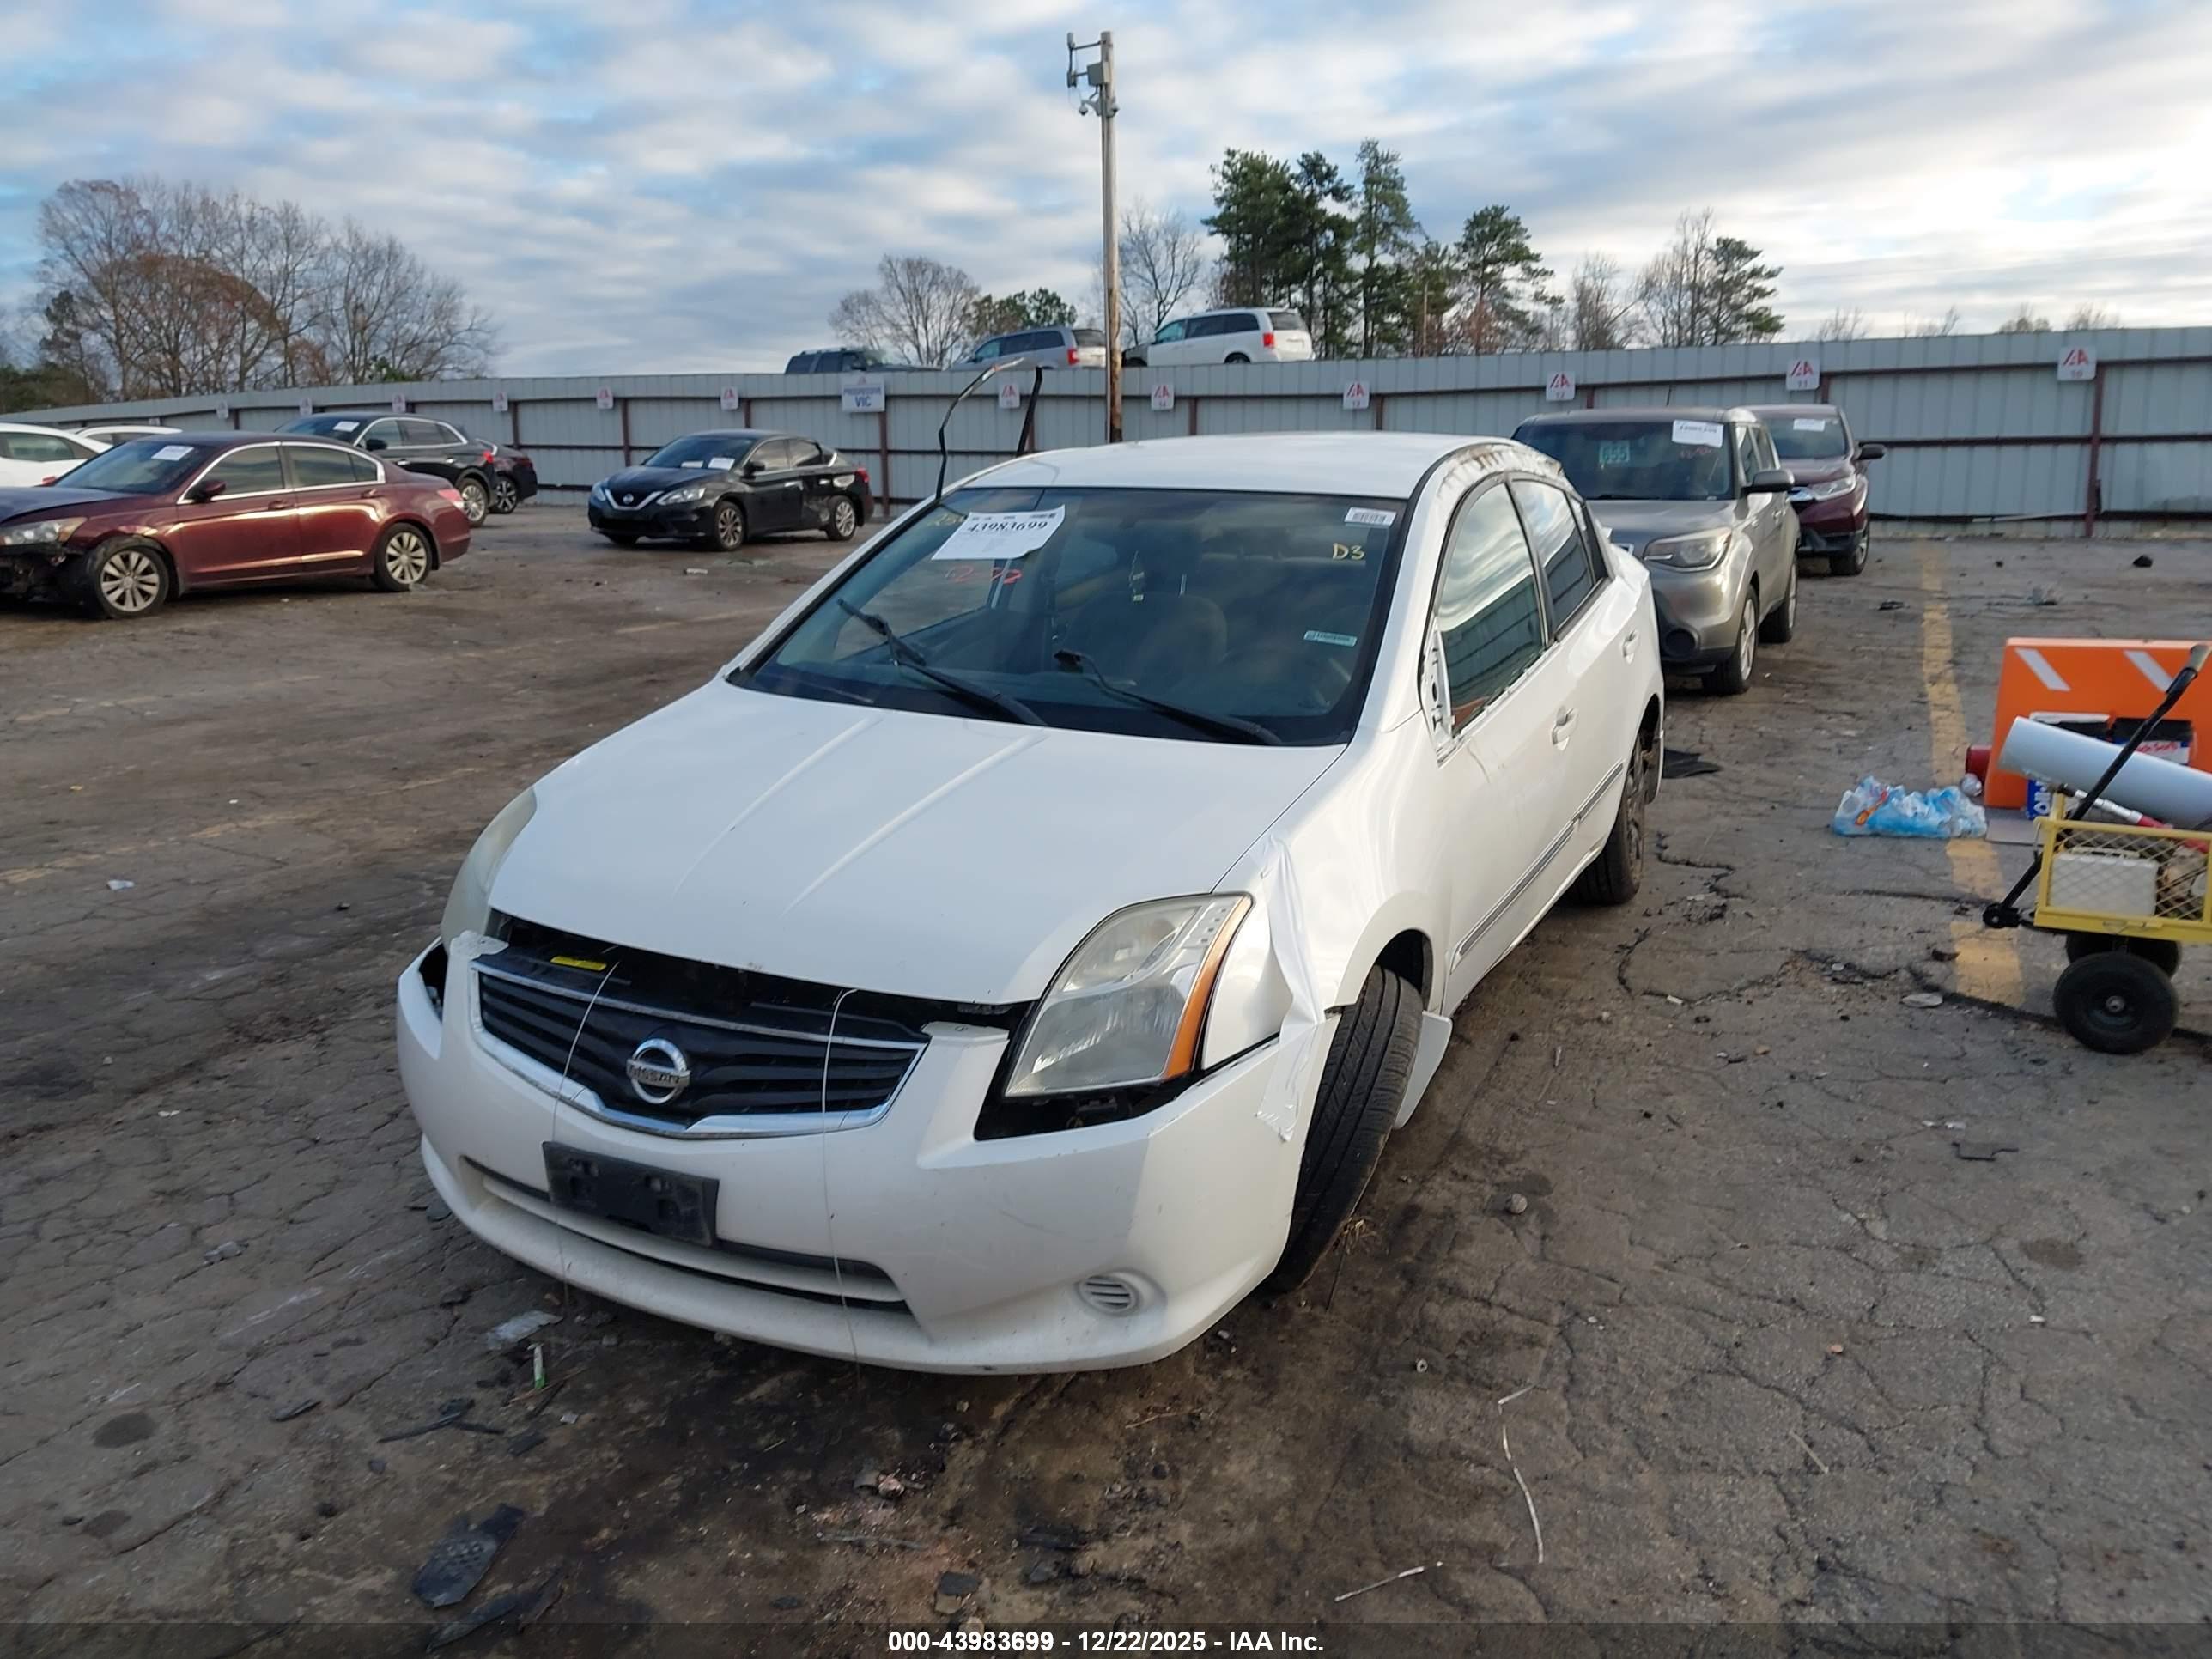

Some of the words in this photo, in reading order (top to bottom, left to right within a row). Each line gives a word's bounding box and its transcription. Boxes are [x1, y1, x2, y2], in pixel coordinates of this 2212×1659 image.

[854, 396, 872, 407] VIC
[1332, 542, 1365, 560] D3
[630, 1064, 681, 1084] NISSAN
